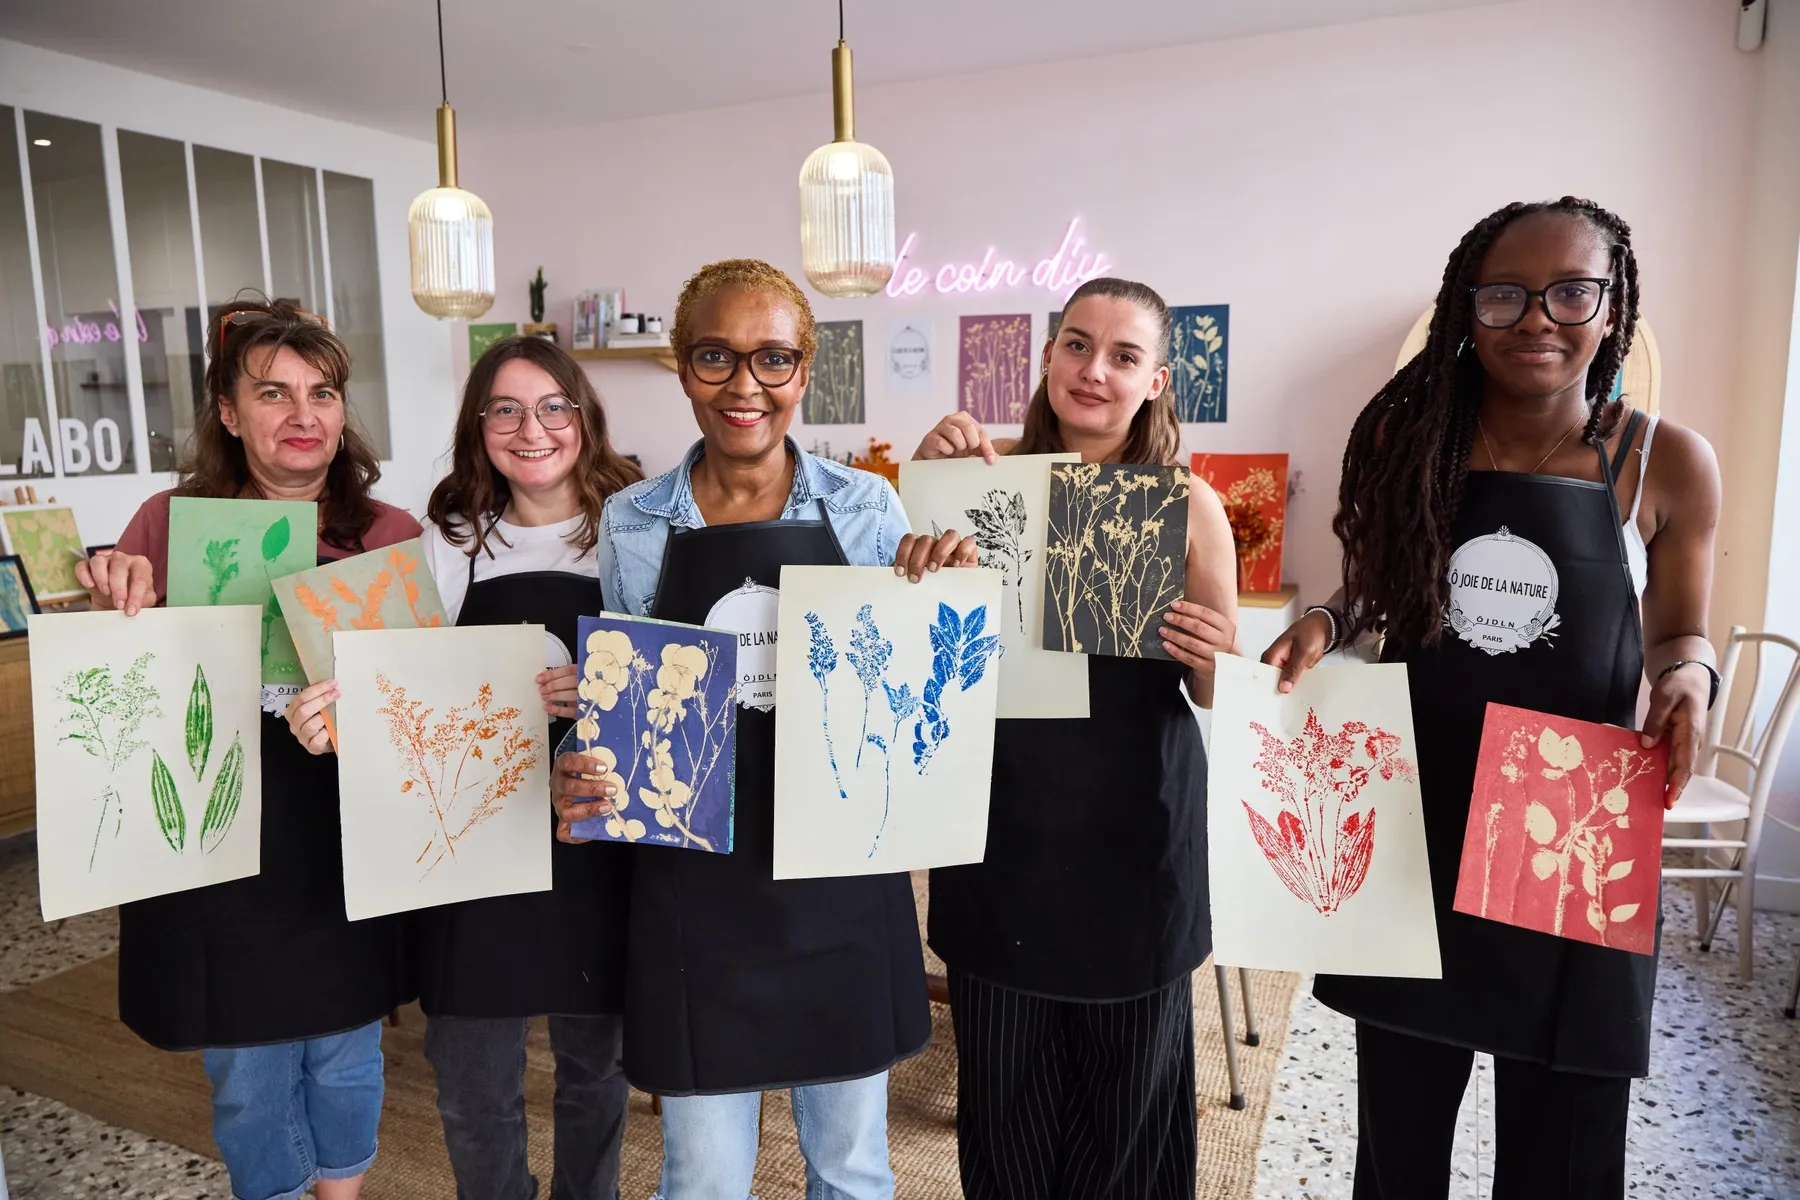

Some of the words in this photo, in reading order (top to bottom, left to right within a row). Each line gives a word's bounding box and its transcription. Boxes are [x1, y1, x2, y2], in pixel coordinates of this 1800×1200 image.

[886, 231, 929, 298] le
[935, 245, 1027, 294] coin
[0, 417, 122, 475] ABO
[1451, 569, 1458, 585] Ô
[1459, 573, 1479, 588] JOIE
[1481, 576, 1494, 590] DE
[1495, 579, 1507, 592] LA
[1510, 581, 1548, 599] NATURE
[740, 633, 751, 646] DE
[754, 632, 765, 645] LA
[1482, 634, 1503, 643] PARIS
